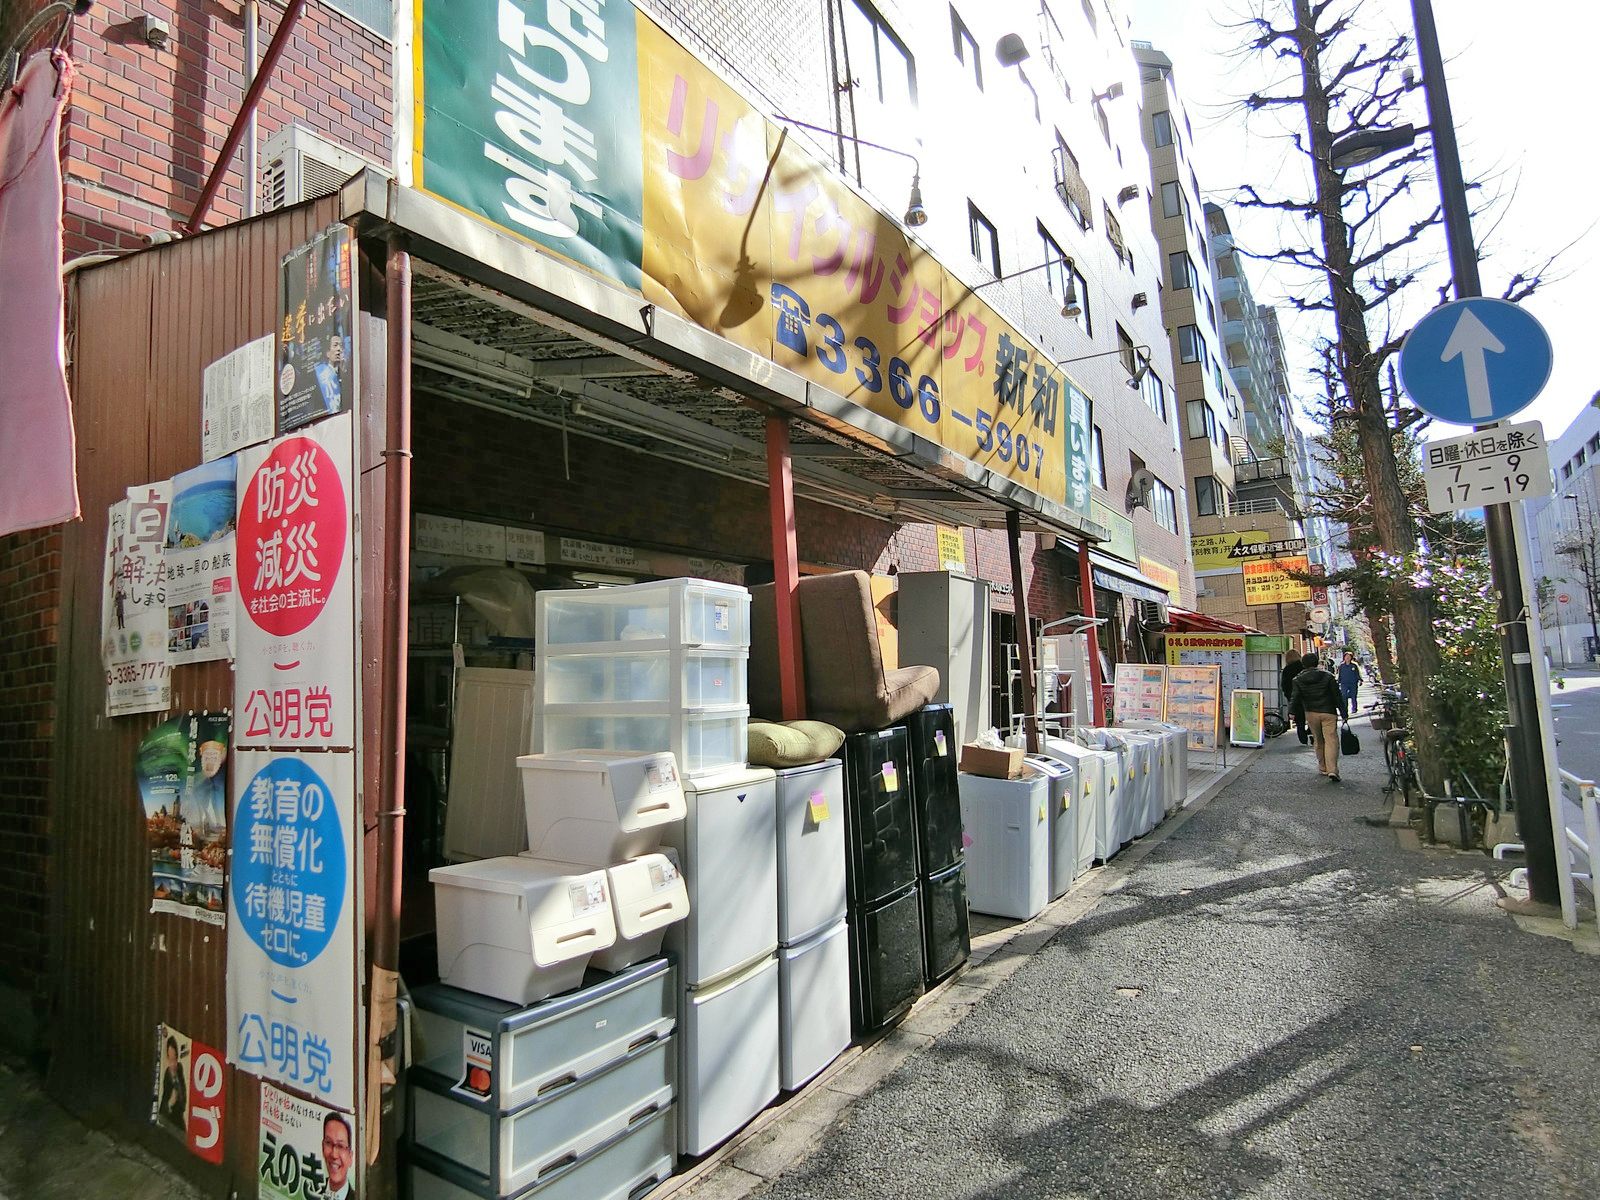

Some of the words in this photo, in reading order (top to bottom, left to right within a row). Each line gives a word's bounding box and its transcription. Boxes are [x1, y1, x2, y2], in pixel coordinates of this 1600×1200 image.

[815, 313, 1045, 480] 3366-5907
[993, 332, 1060, 438] 新和
[1069, 386, 1087, 508] 買います
[1429, 431, 1538, 465] 日曜・休日を除く
[418, 518, 460, 533] 買います
[167, 552, 232, 581] 地球一周の船旅
[250, 590, 327, 614] を社会の主流に。
[244, 685, 333, 738] 公明党
[251, 777, 324, 823] 教育の
[250, 821, 323, 874] 無償化
[272, 871, 298, 886] とともに
[245, 881, 326, 932] 待機児童
[260, 924, 308, 962] ゼロに。
[238, 1013, 332, 1094] 公明党
[470, 1038, 492, 1057] VISA
[263, 1086, 322, 1121] ひとりが始めなければ
[263, 1101, 302, 1129] 何も始まらない
[260, 1131, 328, 1200] えのき
